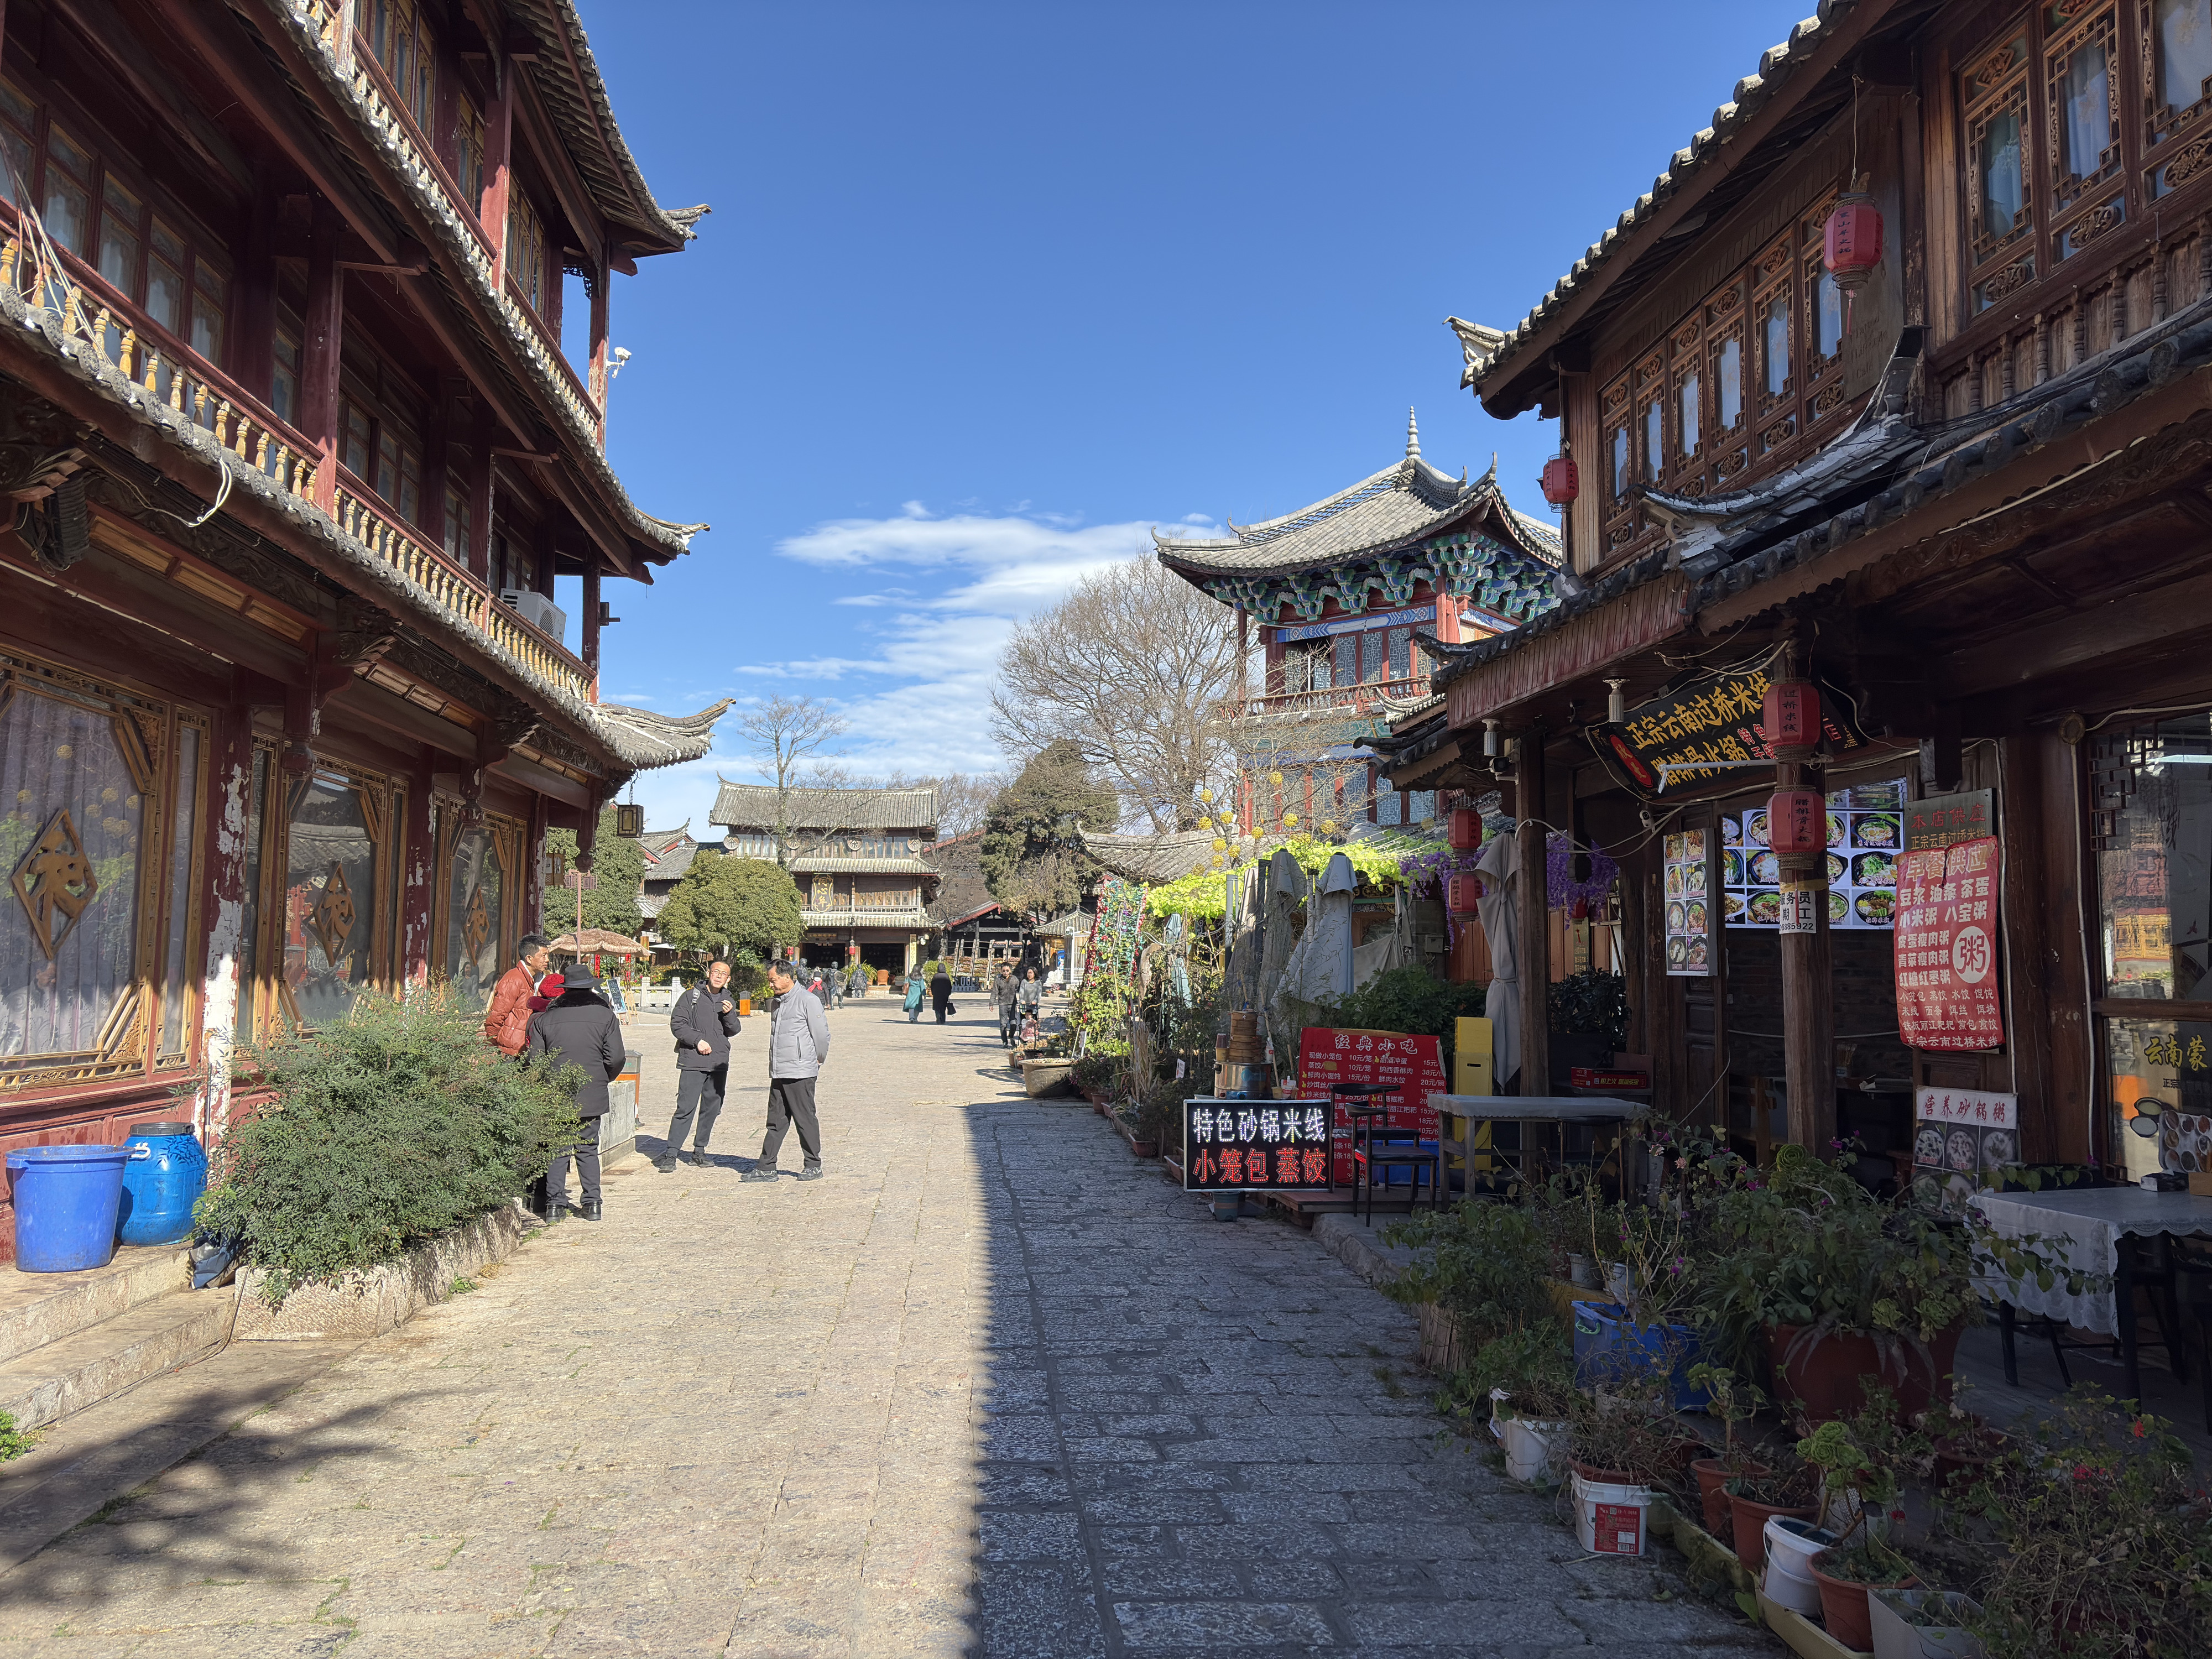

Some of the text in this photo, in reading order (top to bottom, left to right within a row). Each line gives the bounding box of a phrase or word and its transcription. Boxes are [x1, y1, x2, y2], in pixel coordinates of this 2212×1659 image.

[1625, 671, 1771, 751] 正宗云南过桥米线
[1782, 690, 1798, 732] 过桥米线
[1911, 803, 1986, 831] 本店供应
[1910, 827, 1986, 850] 正宗云南过桥米线
[1906, 843, 1988, 882] 早餐供应
[1900, 876, 1990, 907] 豆浆 油条 茶蛋
[1899, 900, 1987, 928] 小米粥 八宝粥
[1898, 930, 1949, 949] 皮蛋瘦肉粥
[1898, 949, 1949, 968] 青菜瘦肉粥
[1957, 935, 1986, 974] 粥
[1898, 969, 1951, 987] 红糖红枣粥
[1900, 987, 1995, 1003] 小笼包 蒸饺 水饺 馄饨
[1901, 1003, 1996, 1017] 米线 面条 饵丝 饵块
[1903, 1018, 1999, 1032] 铁板丽江粑粑 煎包 煎饺
[1334, 1034, 1418, 1055] 经典小吃
[1906, 1033, 1999, 1048] 正宗云南过桥米线
[1308, 1052, 1373, 1063] 现做小笼包 10元/笼
[1379, 1055, 1408, 1065] 甜酒冲蛋
[2144, 1034, 2208, 1072] 云南蒙
[1307, 1071, 1371, 1082] 鲜肉小馄饨 15元/份
[1348, 1064, 1372, 1072] 10元/笼
[1379, 1066, 1413, 1075] 纳西香酥肉
[1378, 1076, 1406, 1084] 鲜肉水饺
[1925, 1094, 2005, 1123] 营养砂锅粥
[1192, 1108, 1326, 1143] 特色砂锅米线
[1375, 1114, 1396, 1123] 炸豆
[1192, 1147, 1326, 1184] 小笼包 蒸饺
